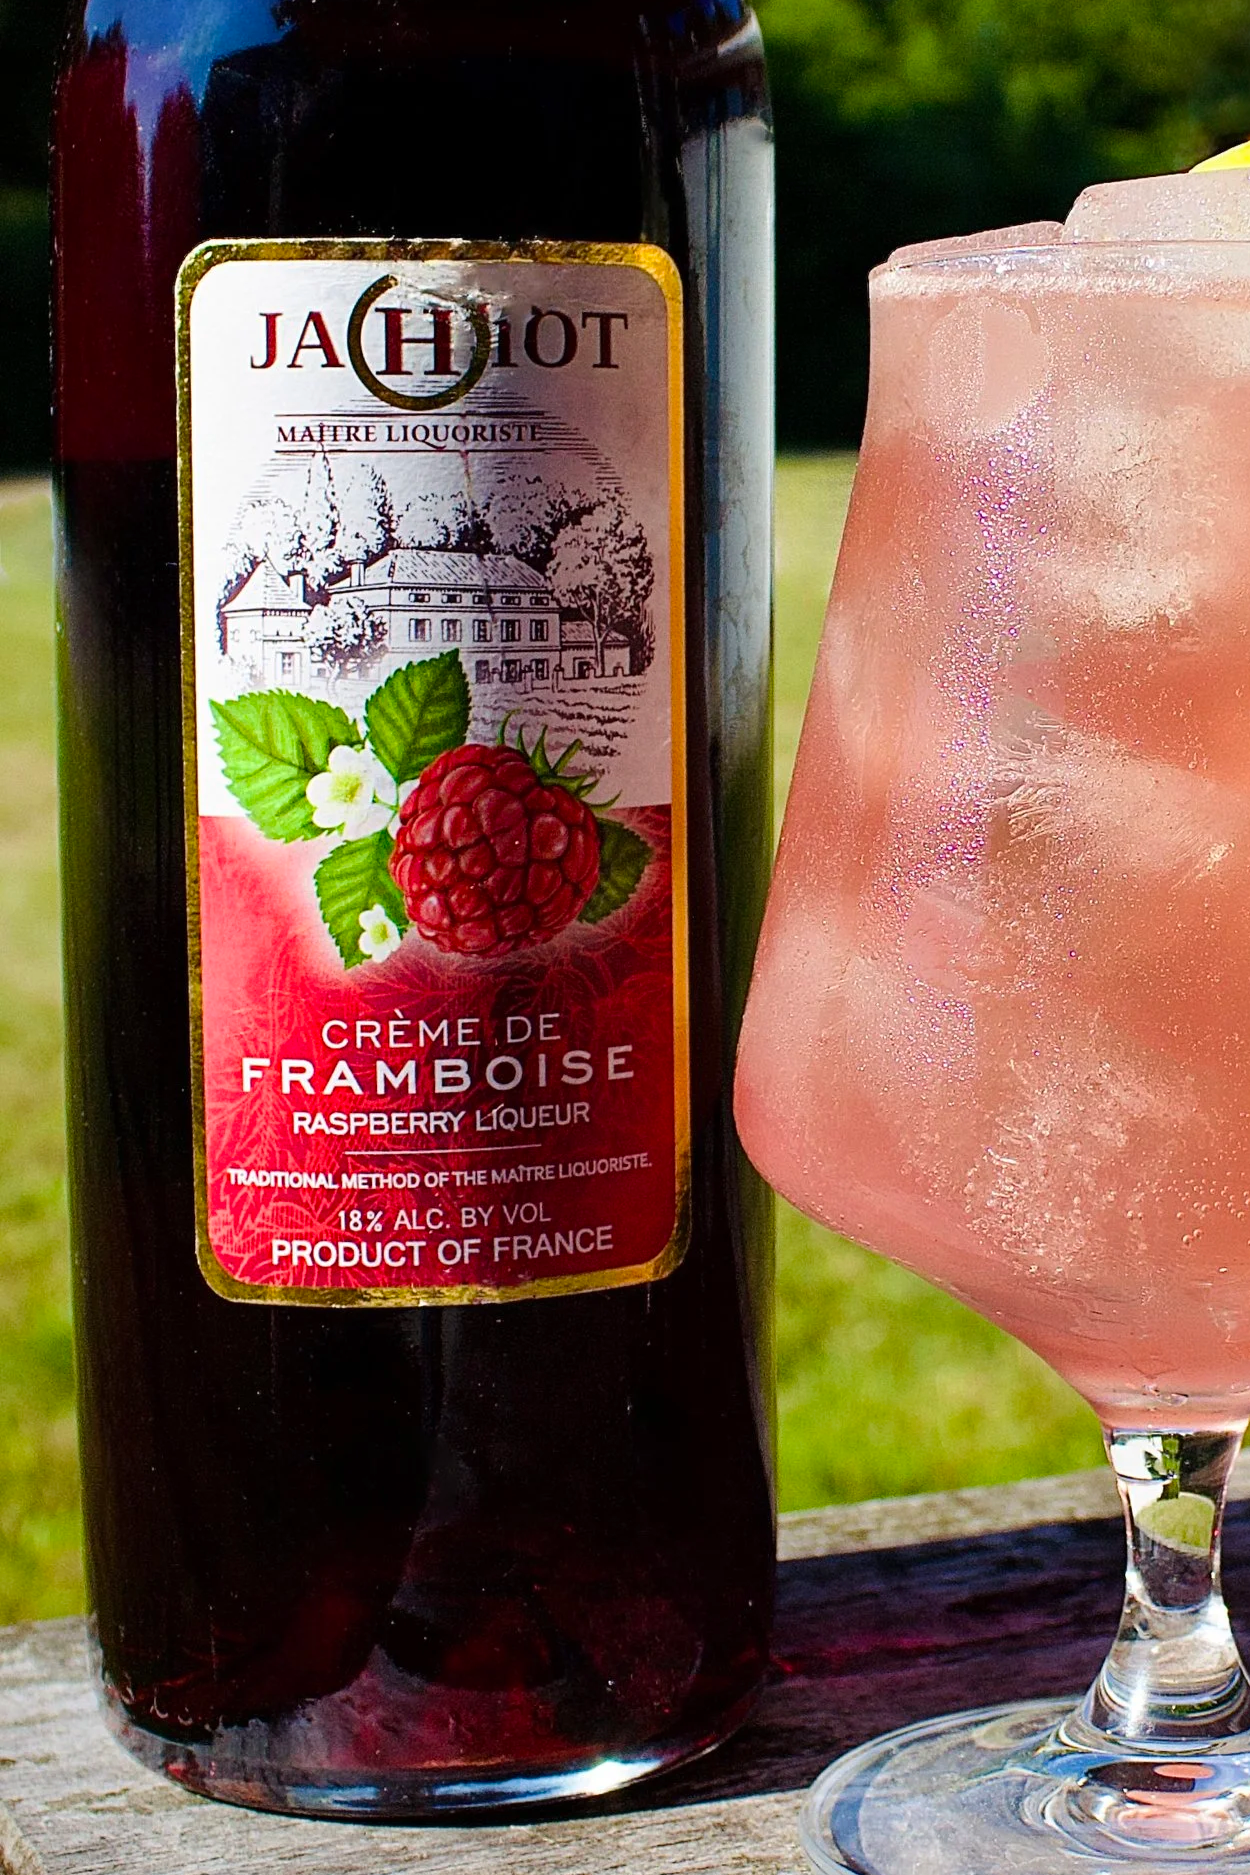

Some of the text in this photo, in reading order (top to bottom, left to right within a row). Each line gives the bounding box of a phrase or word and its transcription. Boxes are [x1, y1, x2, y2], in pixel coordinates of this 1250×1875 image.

[387, 423, 541, 449] LIQUORISTE
[322, 1009, 561, 1049] CRÈME DE
[242, 1045, 634, 1095] FRAMBOISE
[293, 1102, 590, 1136] RASPBERRY LIQUEUR
[227, 1153, 652, 1189] TRADITIONAL METHOD OF THE MAÎTRE LIQUORISTE.
[338, 1202, 551, 1232] 18% ALC. BY VOL
[271, 1225, 613, 1268] PRODUCT OF FRANCE
